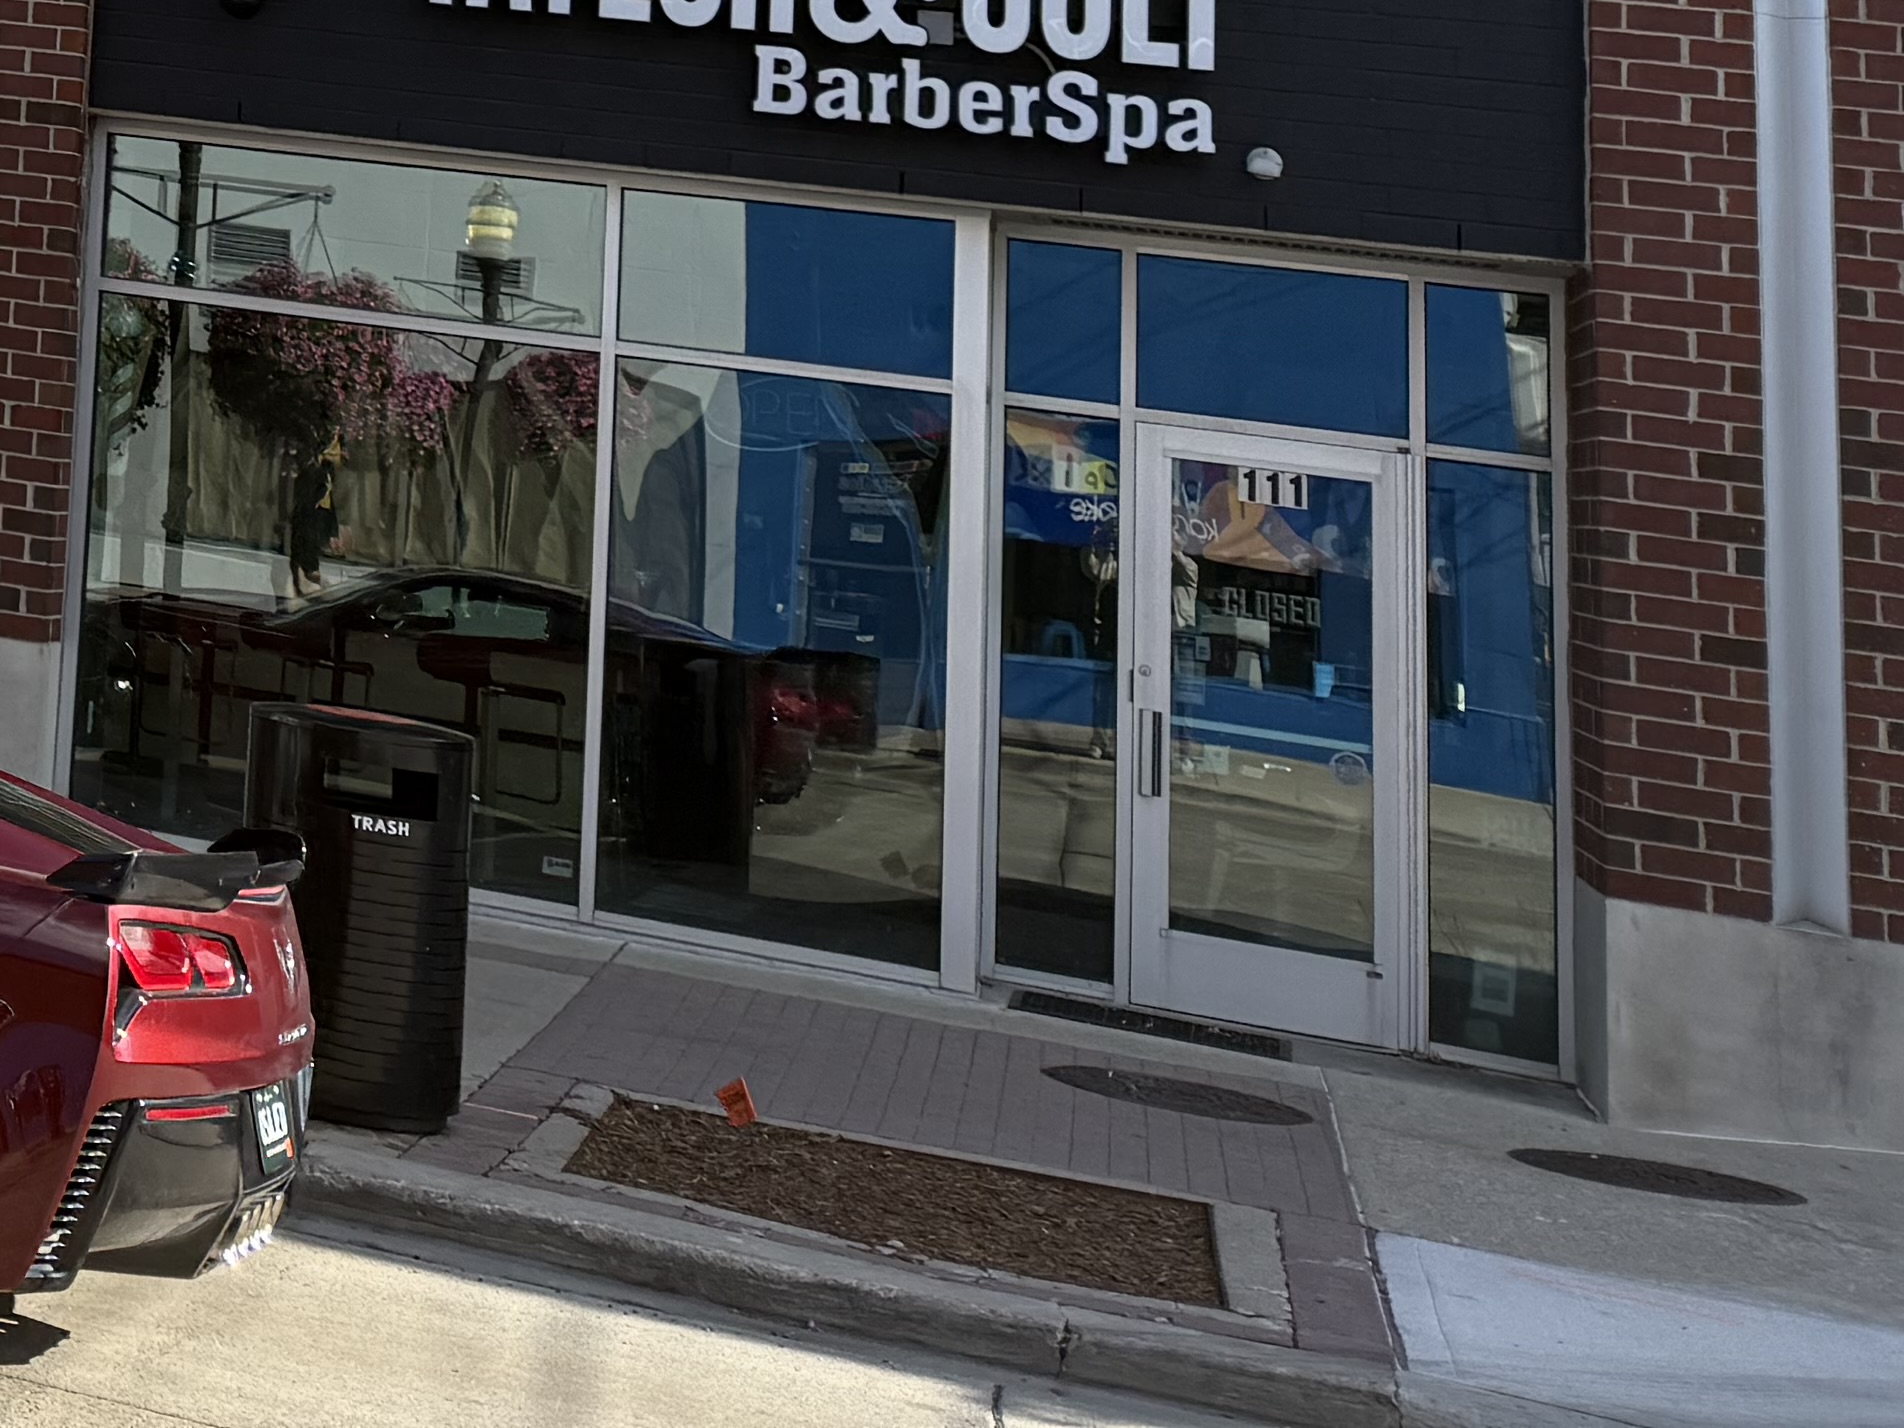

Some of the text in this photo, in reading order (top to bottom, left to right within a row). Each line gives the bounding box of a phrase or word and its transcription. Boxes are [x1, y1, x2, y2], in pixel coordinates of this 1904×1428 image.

[751, 43, 1217, 166] BarberSpa
[1242, 469, 1304, 508] 111
[1217, 586, 1321, 628] CLOSED
[351, 813, 410, 837] TRASH
